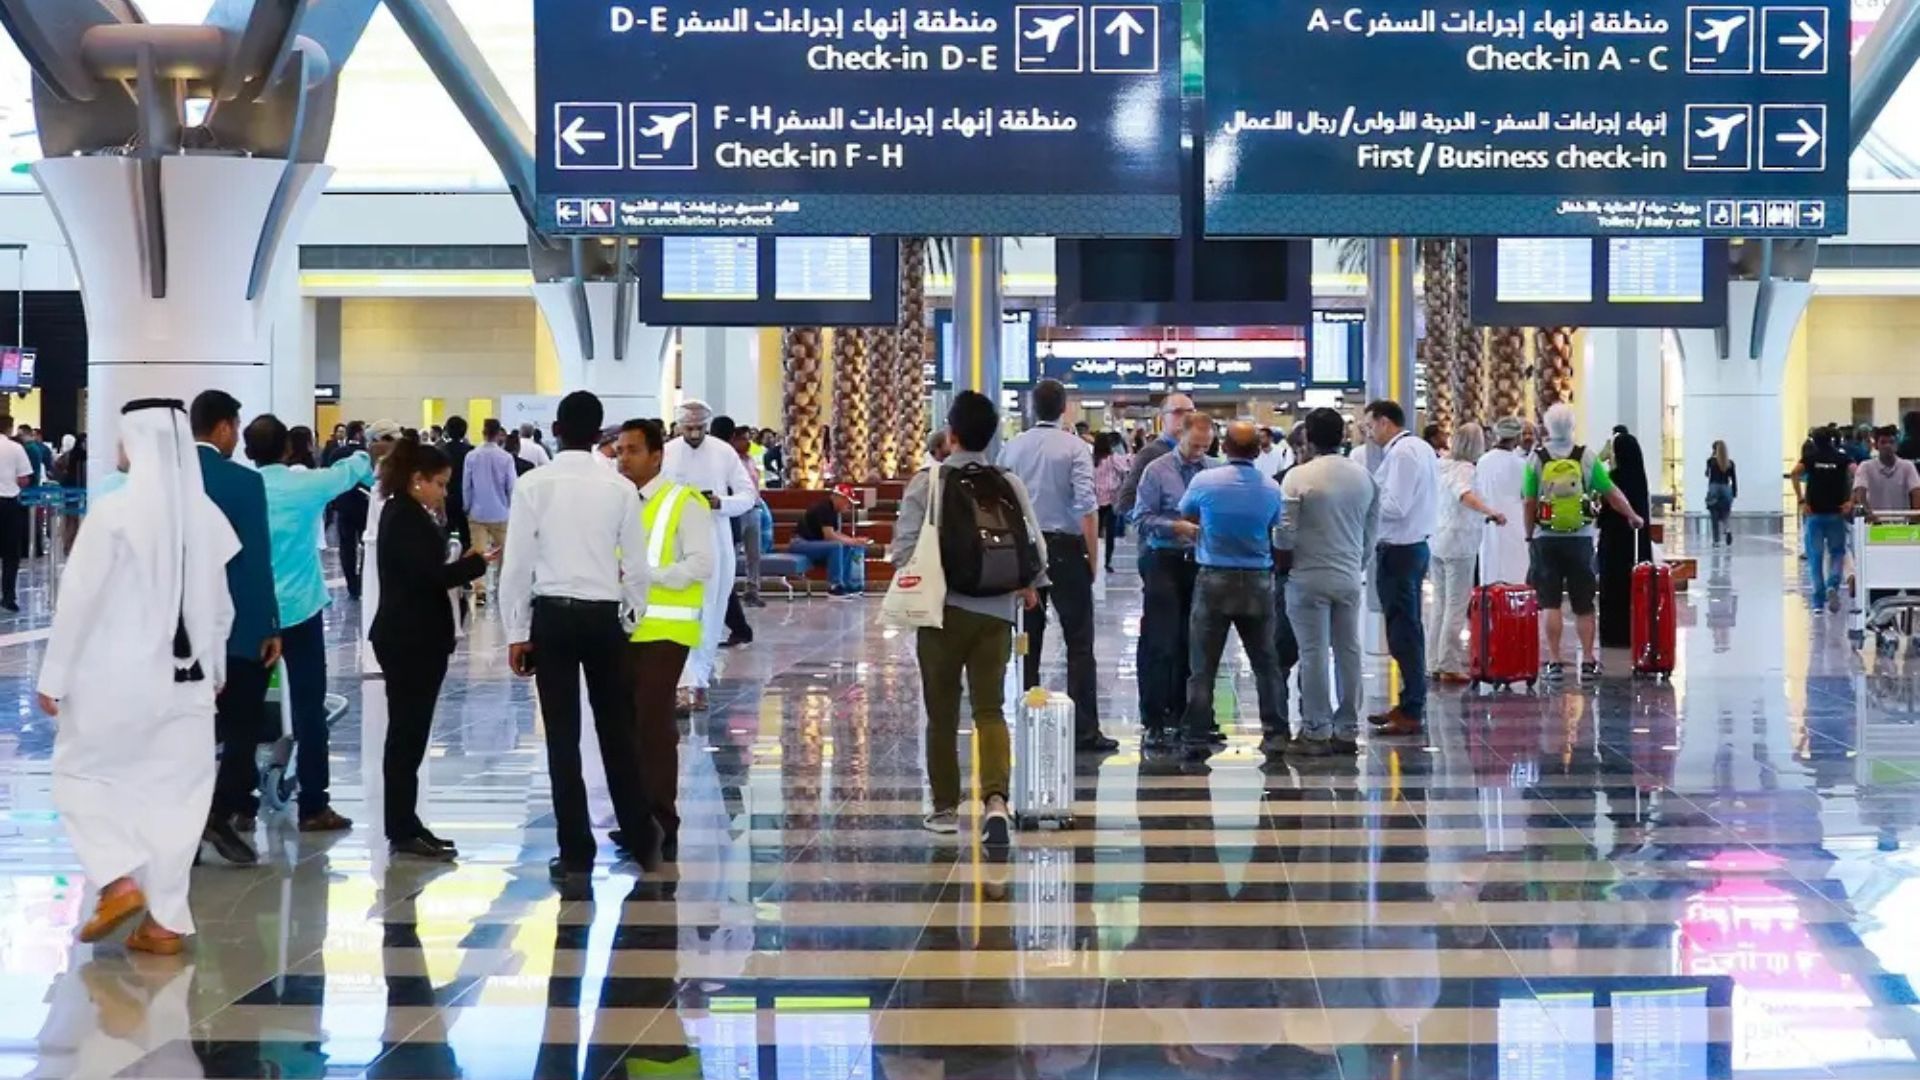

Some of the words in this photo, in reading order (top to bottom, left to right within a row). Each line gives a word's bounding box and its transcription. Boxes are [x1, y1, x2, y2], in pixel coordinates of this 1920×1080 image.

[674, 7, 748, 38] السفر
[754, 7, 844, 39] إجراءات
[852, 7, 907, 40] إنهاء
[913, 7, 998, 33] منطقة
[1366, 9, 1436, 37] السفر
[1441, 9, 1525, 39] إجراءات
[1533, 9, 1584, 41] إنهاء
[1589, 10, 1669, 34] منطقة
[807, 44, 928, 70] Check-in
[1466, 44, 1590, 71] Check-in
[774, 107, 844, 136] السفر
[849, 107, 934, 137] إجراءات
[941, 107, 993, 138] إنهاء
[998, 107, 1078, 131] منطقة
[1224, 109, 1293, 135] الأعمال
[1420, 111, 1476, 135] الدرجة
[1493, 111, 1550, 134] السفر
[1554, 111, 1621, 136] إجراءات
[1626, 111, 1667, 137] إنهاء
[715, 141, 837, 168] Check-in
[1556, 143, 1667, 169] check-in
[622, 214, 645, 226] Visa
[648, 214, 716, 226] cancellation
[719, 215, 773, 228] pre-check
[1676, 218, 1701, 227] care
